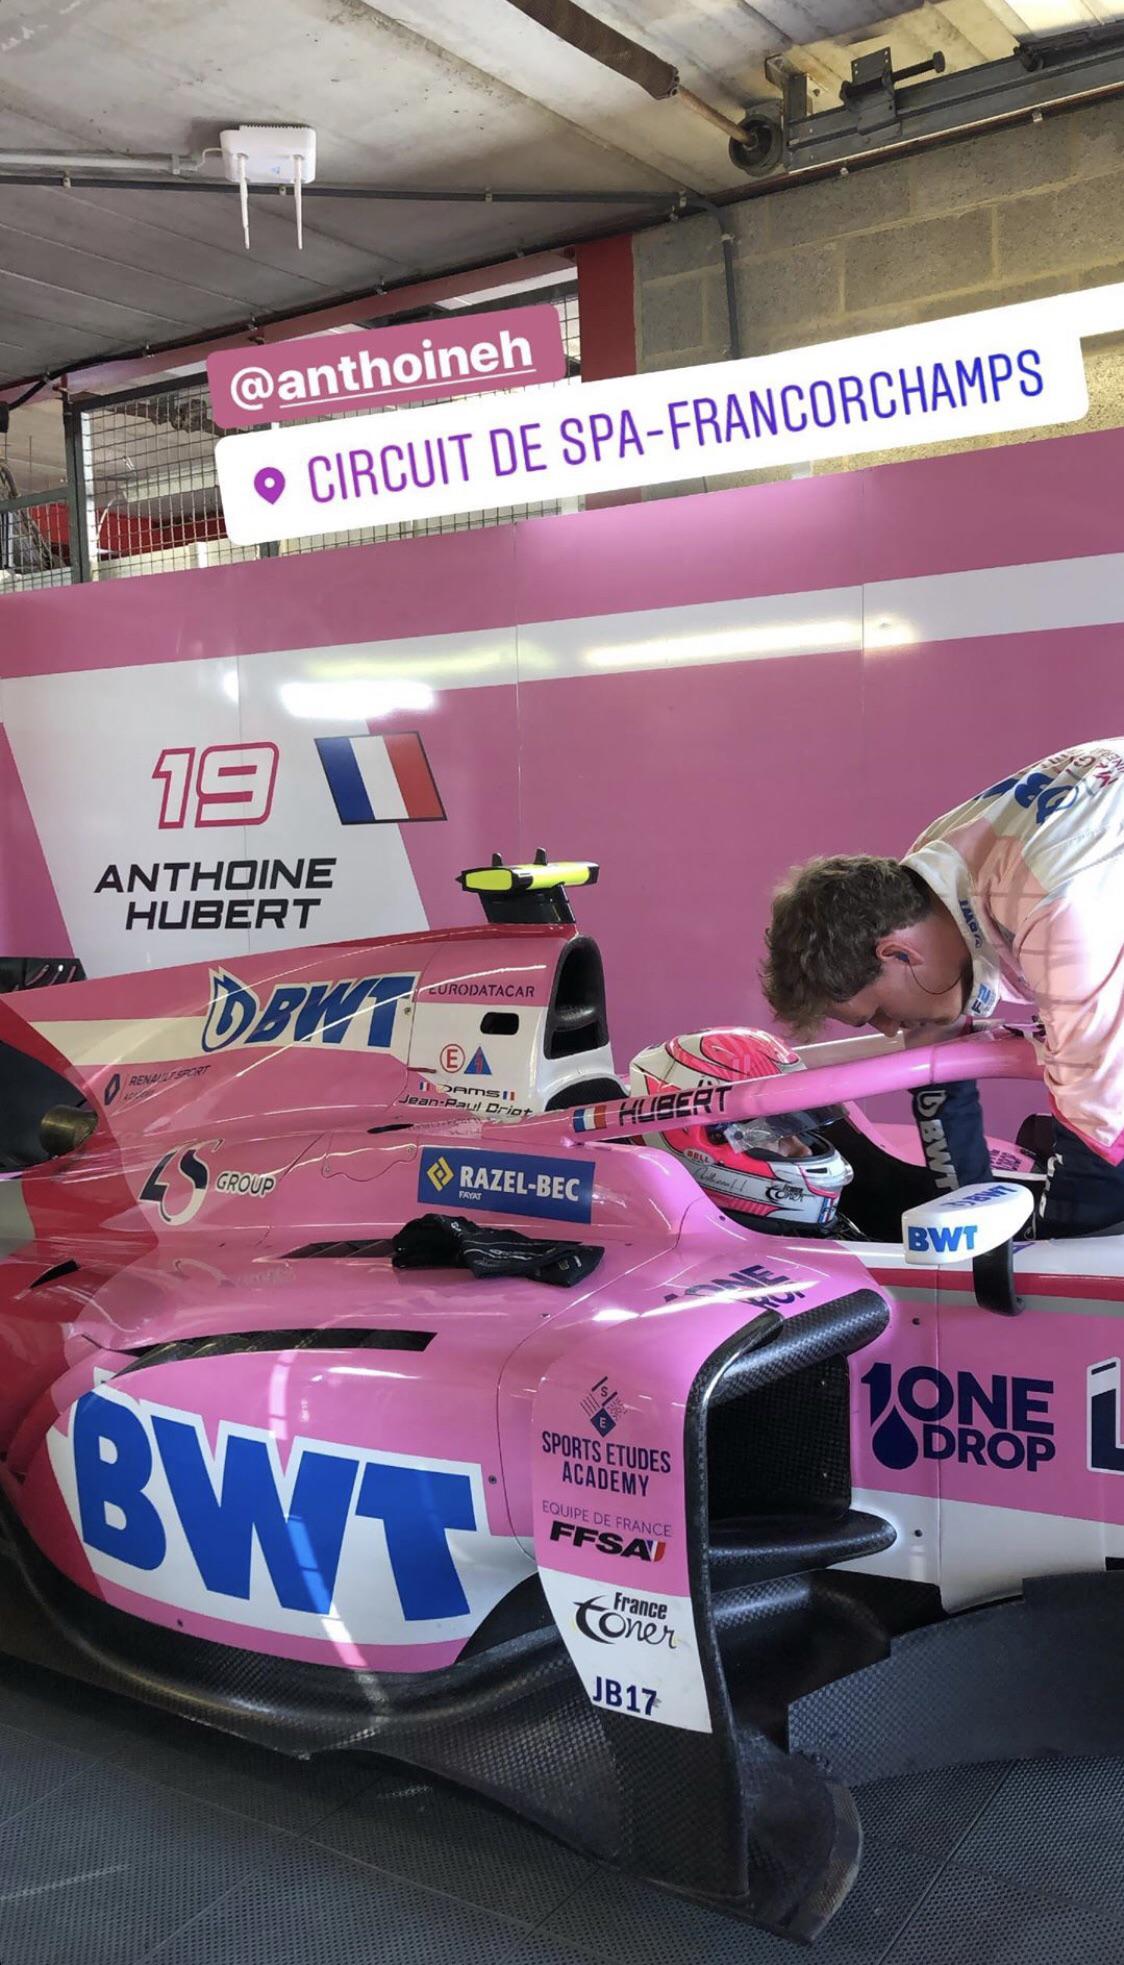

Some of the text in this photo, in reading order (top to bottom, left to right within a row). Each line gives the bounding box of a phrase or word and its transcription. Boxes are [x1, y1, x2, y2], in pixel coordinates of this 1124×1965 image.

[152, 741, 280, 830] 19
[94, 857, 337, 894] ANTHOINE
[125, 897, 322, 931] HUBERT
[428, 983, 535, 998] EURODATACAR
[243, 974, 417, 1049] BWT
[619, 1085, 733, 1127] HUBERT
[920, 1118, 961, 1191] BWT
[216, 1171, 276, 1197] GROUP
[458, 1190, 483, 1201] FAYAT
[459, 1165, 581, 1202] RAZEL-BEC
[907, 1225, 978, 1253] BWT
[542, 1430, 671, 1474] SPORTS ETUDES
[922, 1422, 1056, 1472] DROP
[562, 1460, 650, 1498] ACADEMY
[73, 1390, 477, 1622] BWT
[542, 1499, 673, 1538] EQUIPE DE FRANCE
[549, 1520, 656, 1562] FFSA
[612, 1591, 669, 1620] France
[592, 1675, 658, 1717] JB17
